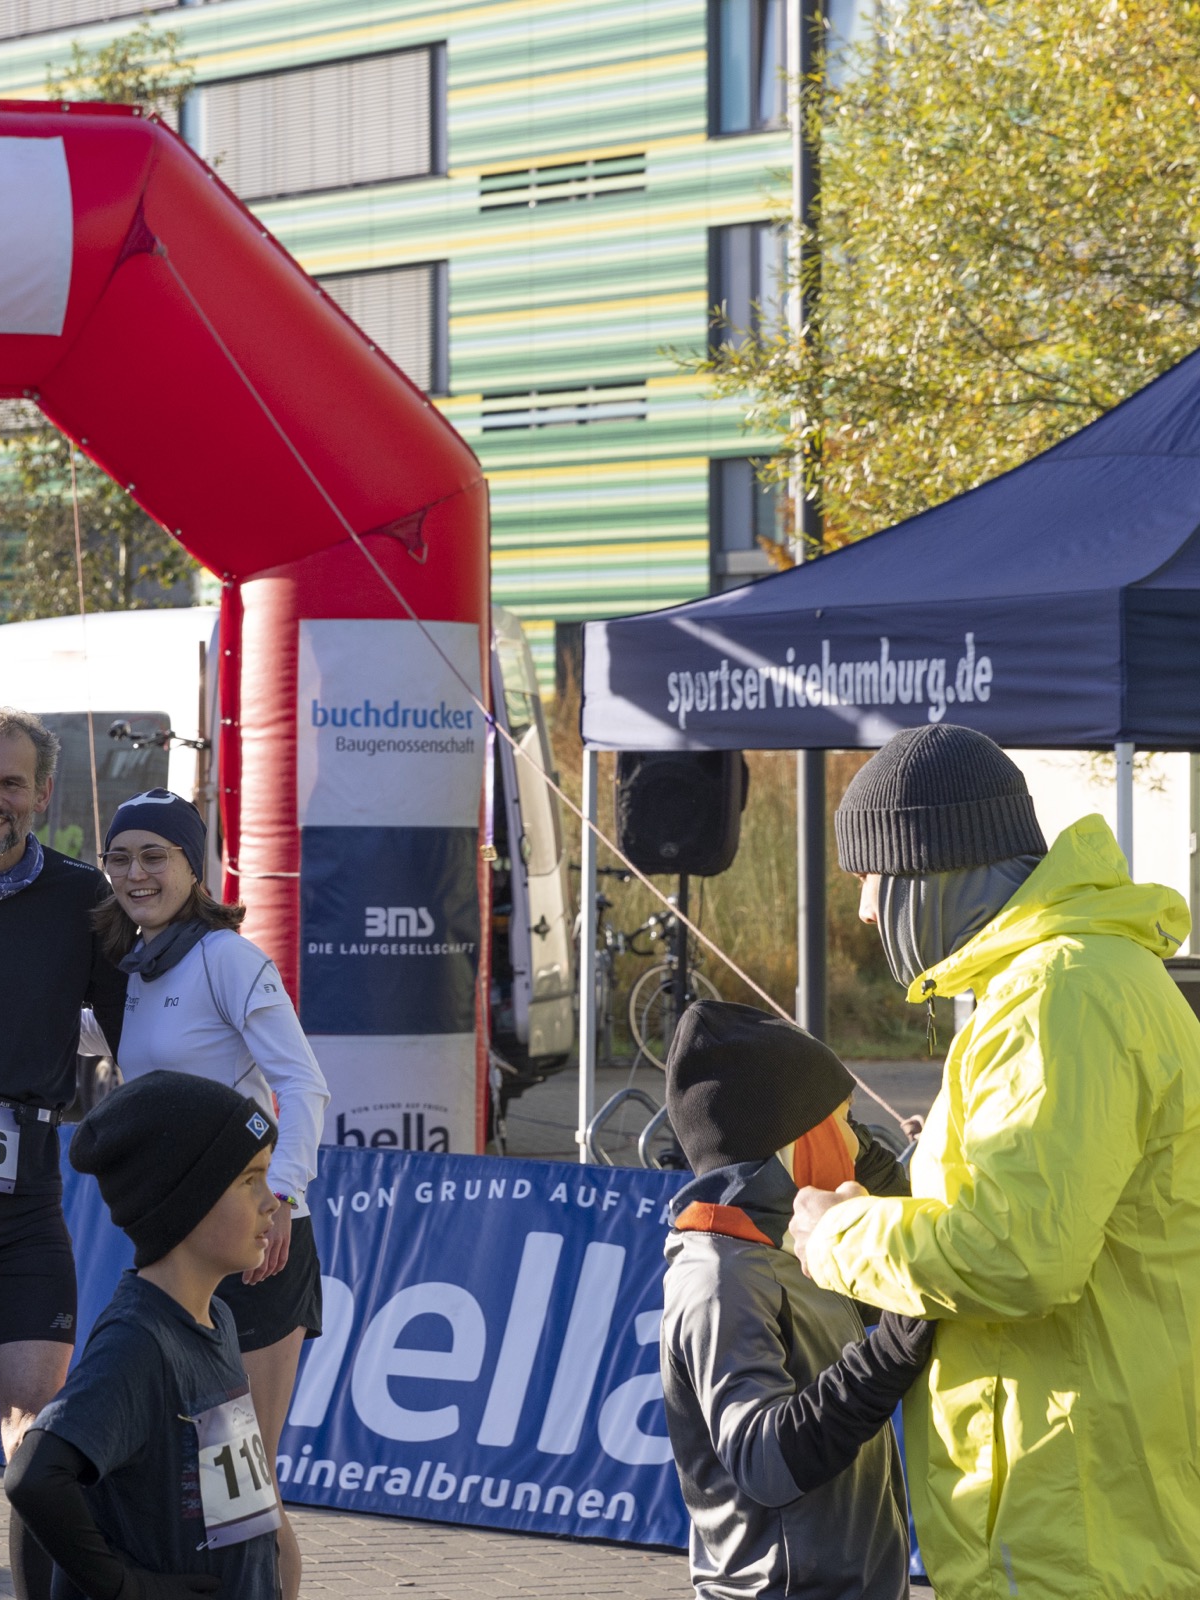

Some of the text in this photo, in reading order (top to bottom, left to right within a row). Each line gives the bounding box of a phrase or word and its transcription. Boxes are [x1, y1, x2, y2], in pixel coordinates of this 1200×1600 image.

[667, 631, 994, 730] sportservicehamburg.de
[311, 699, 474, 730] buchdrucker
[335, 735, 475, 756] Baugenossenschaft
[364, 906, 436, 938] BMS
[308, 942, 476, 955] DIE LAUFGESELLSCHAFT
[327, 1187, 395, 1218] VON
[414, 1178, 532, 1203] GRUND
[549, 1182, 620, 1211] AUF
